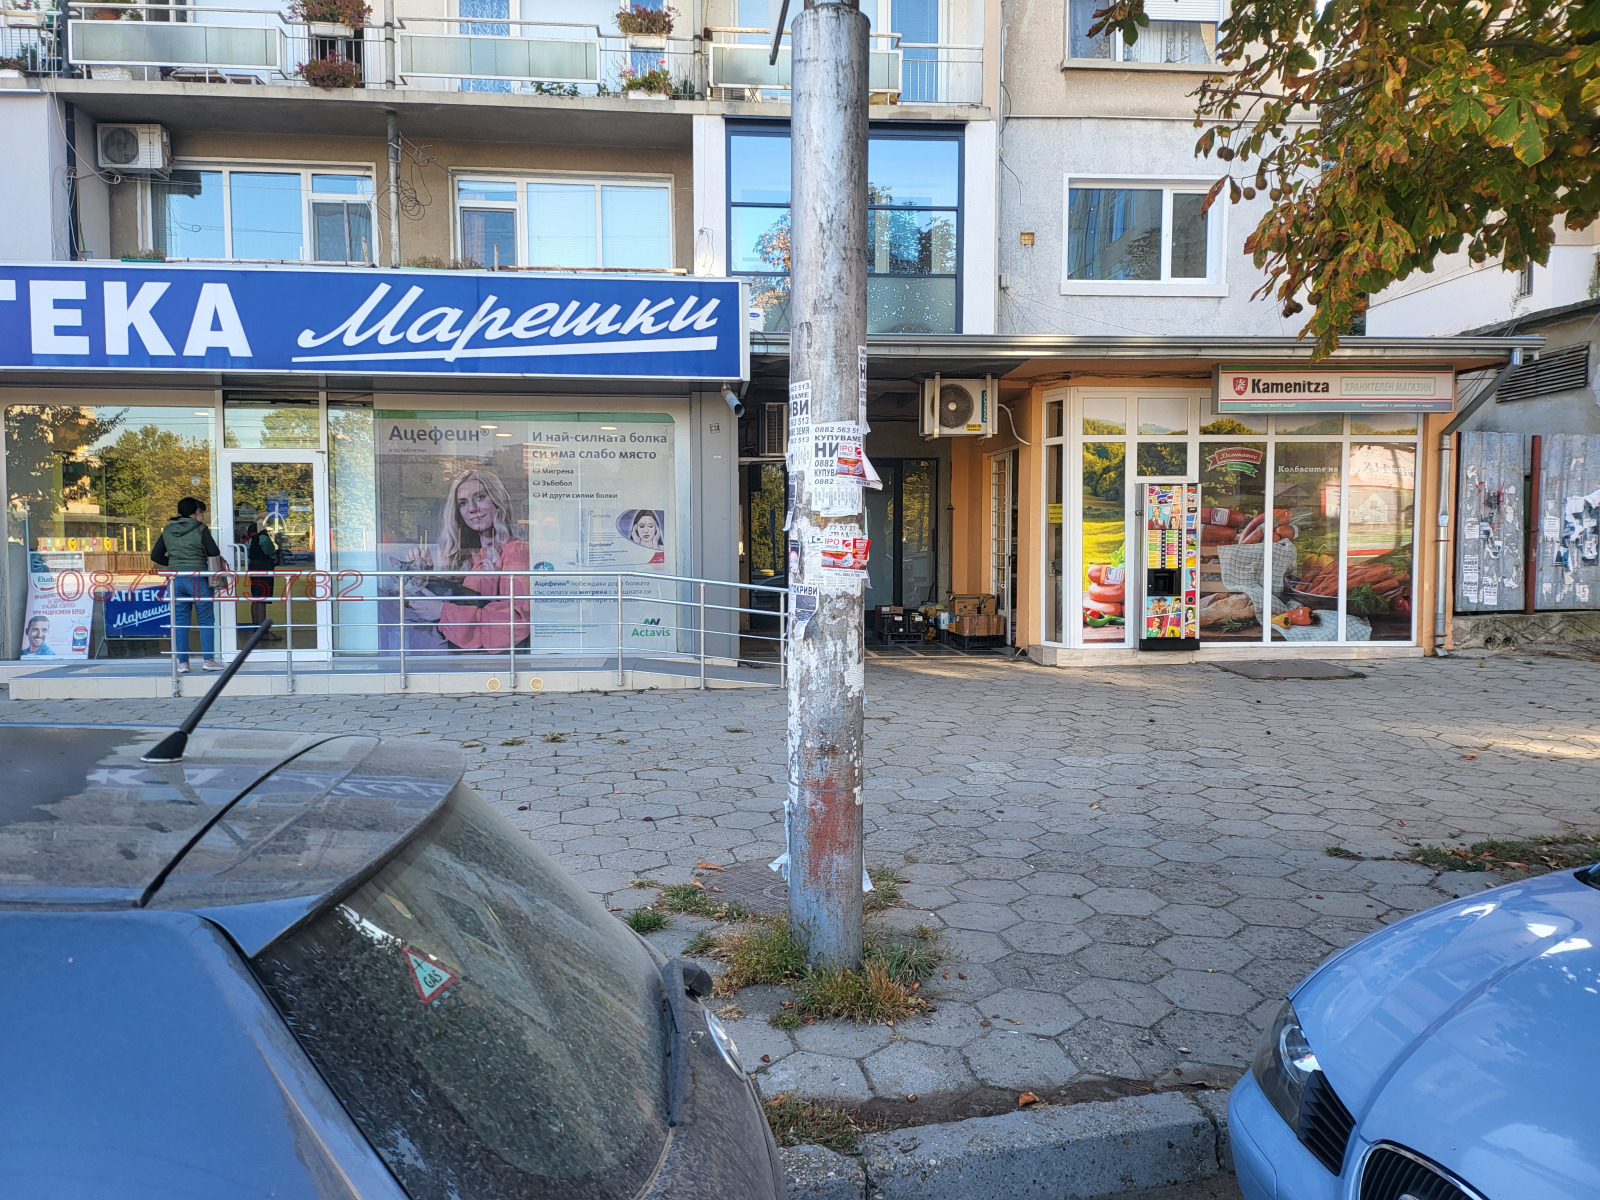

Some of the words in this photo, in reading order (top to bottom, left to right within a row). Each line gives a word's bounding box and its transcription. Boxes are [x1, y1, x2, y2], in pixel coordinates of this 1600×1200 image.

[0, 279, 254, 357] ЕКА
[297, 282, 721, 362] Марешки
[1252, 378, 1329, 393] Kamenitza
[1344, 381, 1394, 392] ХРАНИТЕЛЕН
[1395, 382, 1432, 392] МАГАЗИН
[532, 432, 543, 441] И
[545, 432, 626, 443] най-силната
[629, 432, 667, 444] болка
[814, 434, 862, 443] КУПУВАМЕ
[532, 450, 547, 459] си
[550, 450, 576, 459] има
[578, 448, 616, 459] слабо
[619, 451, 657, 460] място
[814, 459, 834, 467] 0882
[1277, 465, 1325, 473] Колбасите
[541, 479, 573, 487] Зъбобол
[824, 538, 840, 546] IPO
[579, 589, 608, 597] мигрена
[631, 628, 671, 637] Actavis
[423, 970, 443, 989] GAS
